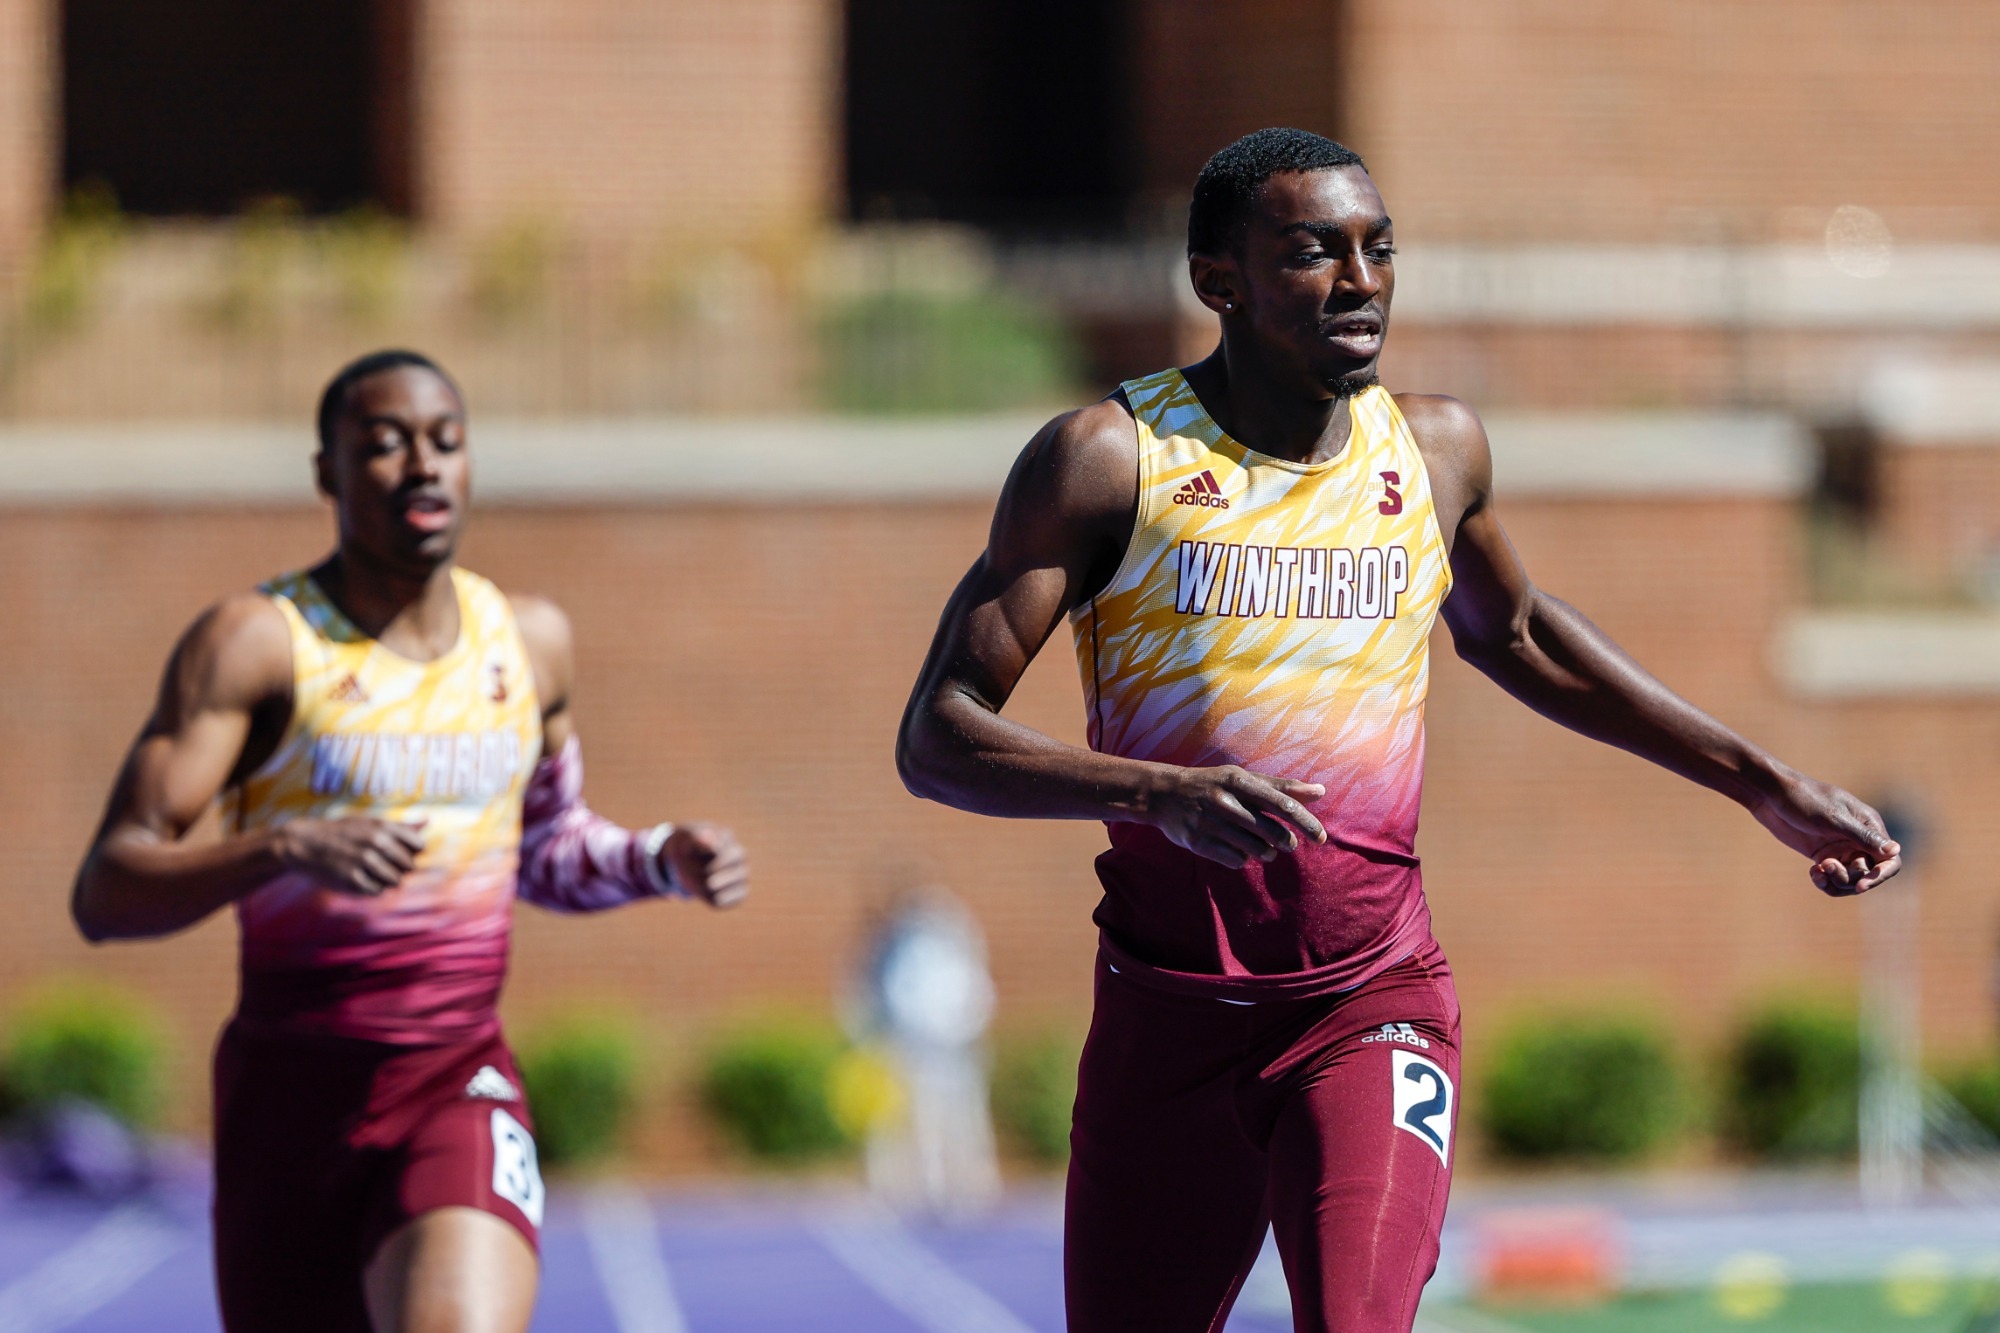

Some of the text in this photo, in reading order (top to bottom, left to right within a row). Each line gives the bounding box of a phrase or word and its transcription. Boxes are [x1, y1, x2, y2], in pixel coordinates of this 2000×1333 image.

[1173, 491, 1229, 509] adidas
[1175, 540, 1409, 619] WINTHROP
[309, 731, 520, 797] WINTHROP
[1361, 1031, 1430, 1049] adidas
[1404, 1062, 1447, 1153] 2
